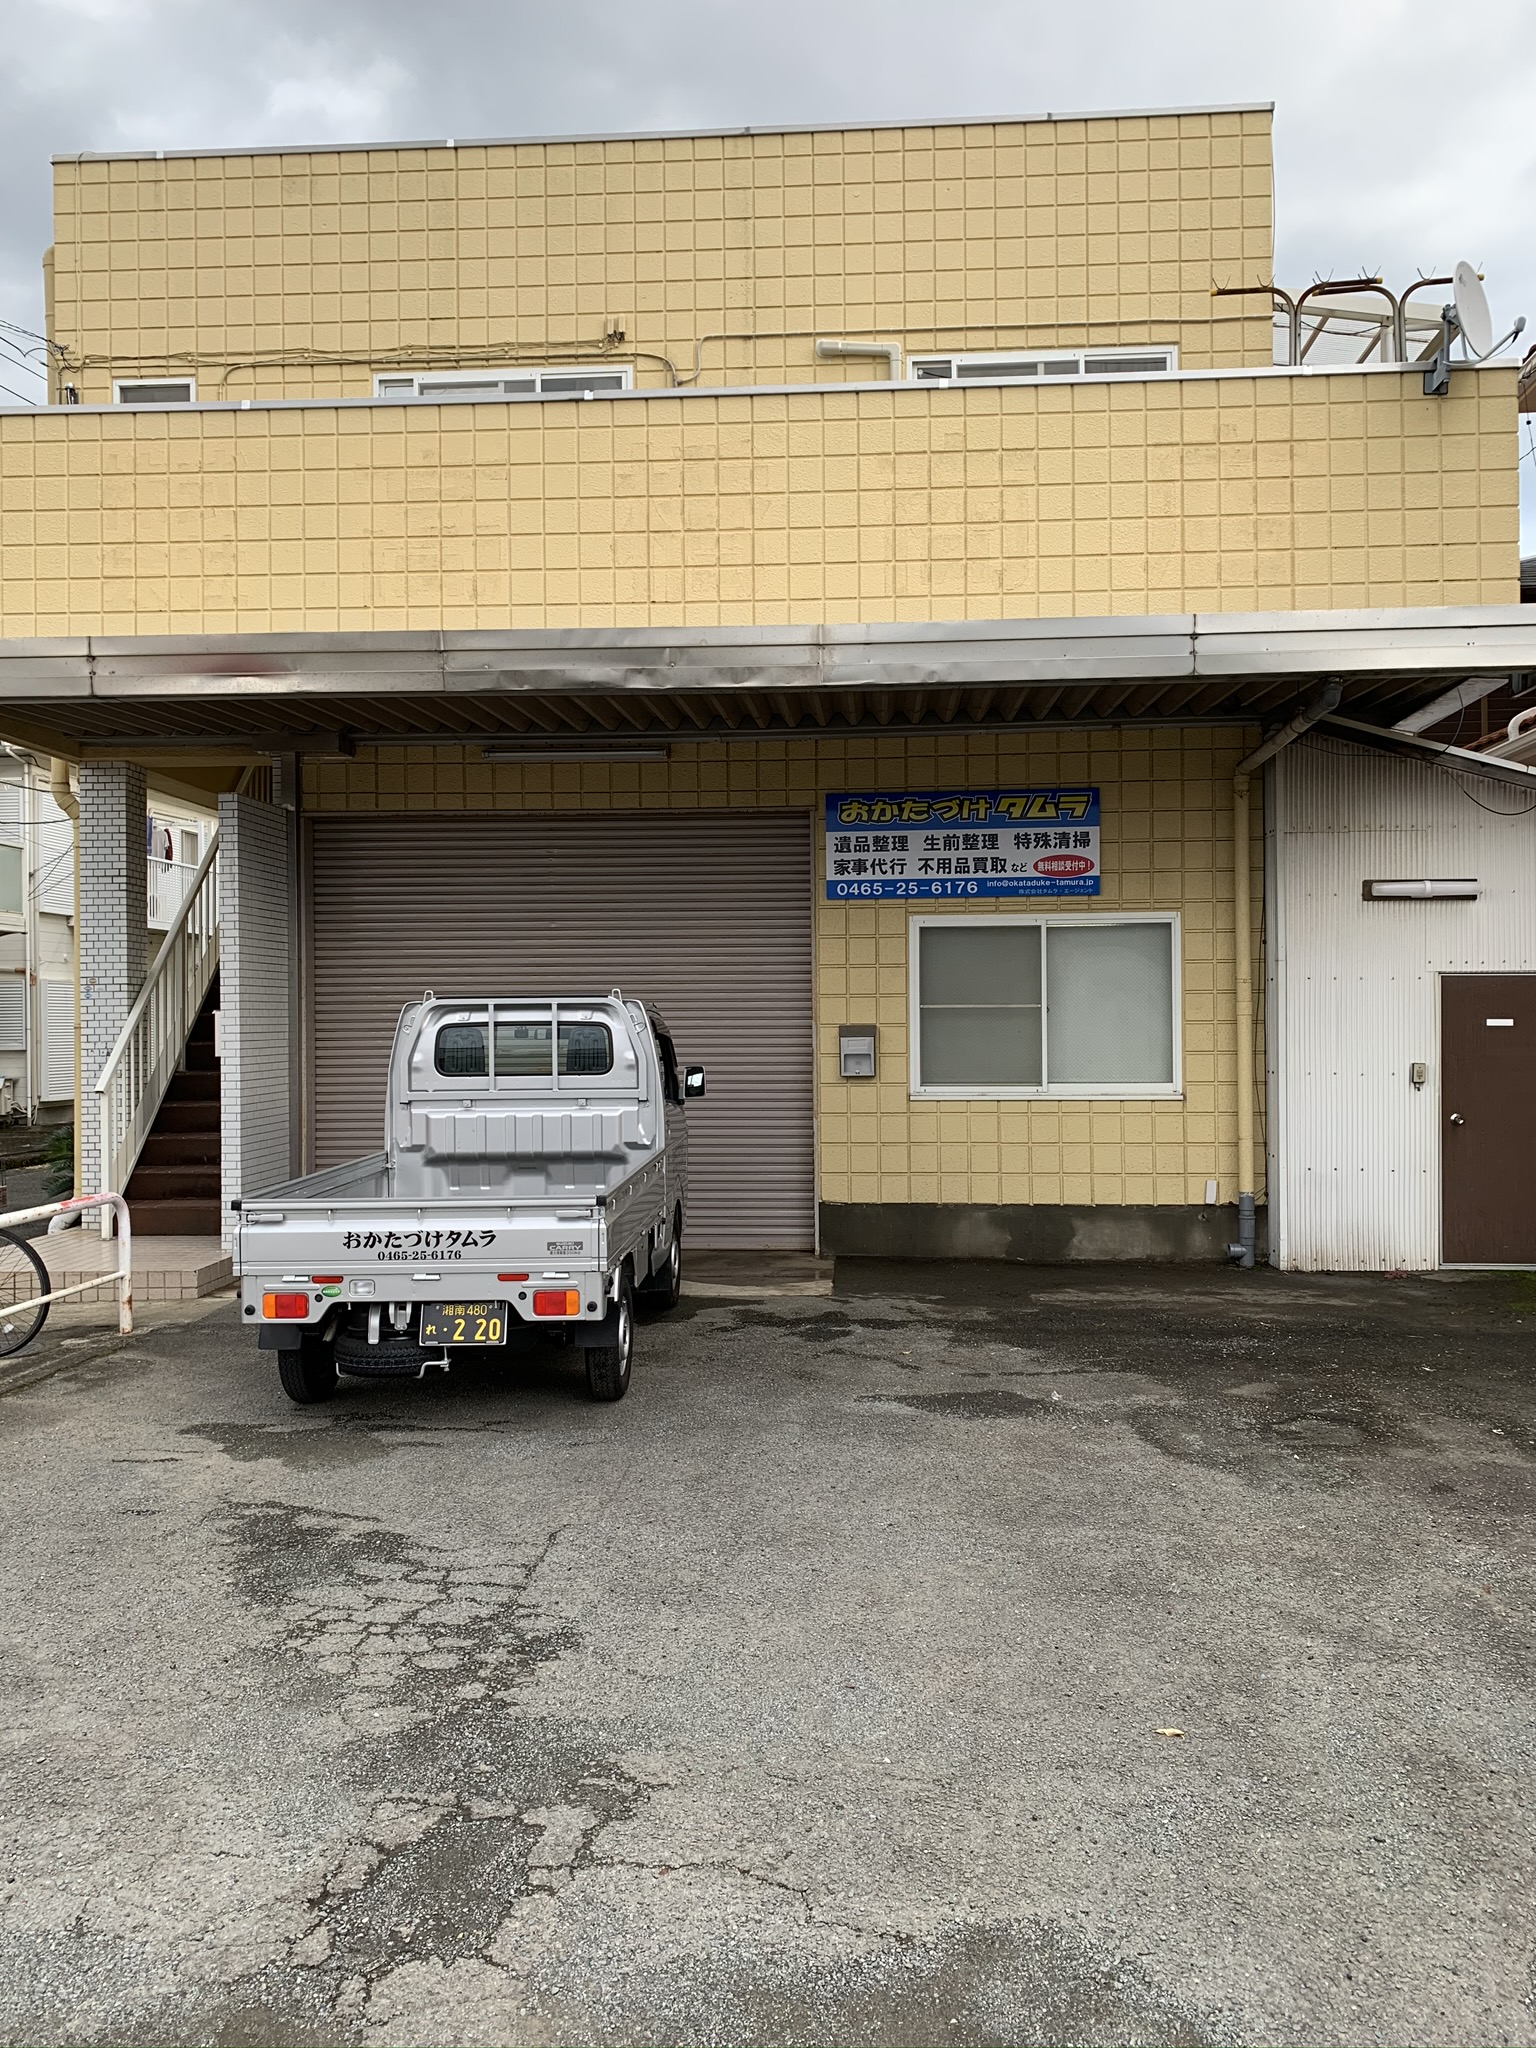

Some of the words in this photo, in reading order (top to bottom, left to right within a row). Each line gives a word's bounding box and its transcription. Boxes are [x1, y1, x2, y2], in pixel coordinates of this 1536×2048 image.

[837, 793, 1092, 825] おかたづけタムラ
[833, 835, 910, 853] 遺品整理
[922, 833, 1000, 851] 生前整理
[1013, 831, 1091, 849] 特殊清掃
[833, 858, 907, 876] 家事代行
[917, 856, 1007, 875] 不用品買取
[1010, 862, 1028, 873] など
[836, 880, 978, 896] 0465-25-6176
[986, 879, 1094, 888] info@okataduke-tamura.jp
[342, 1230, 497, 1249] おかたづけタムラ
[377, 1250, 462, 1261] 0465-25-6176
